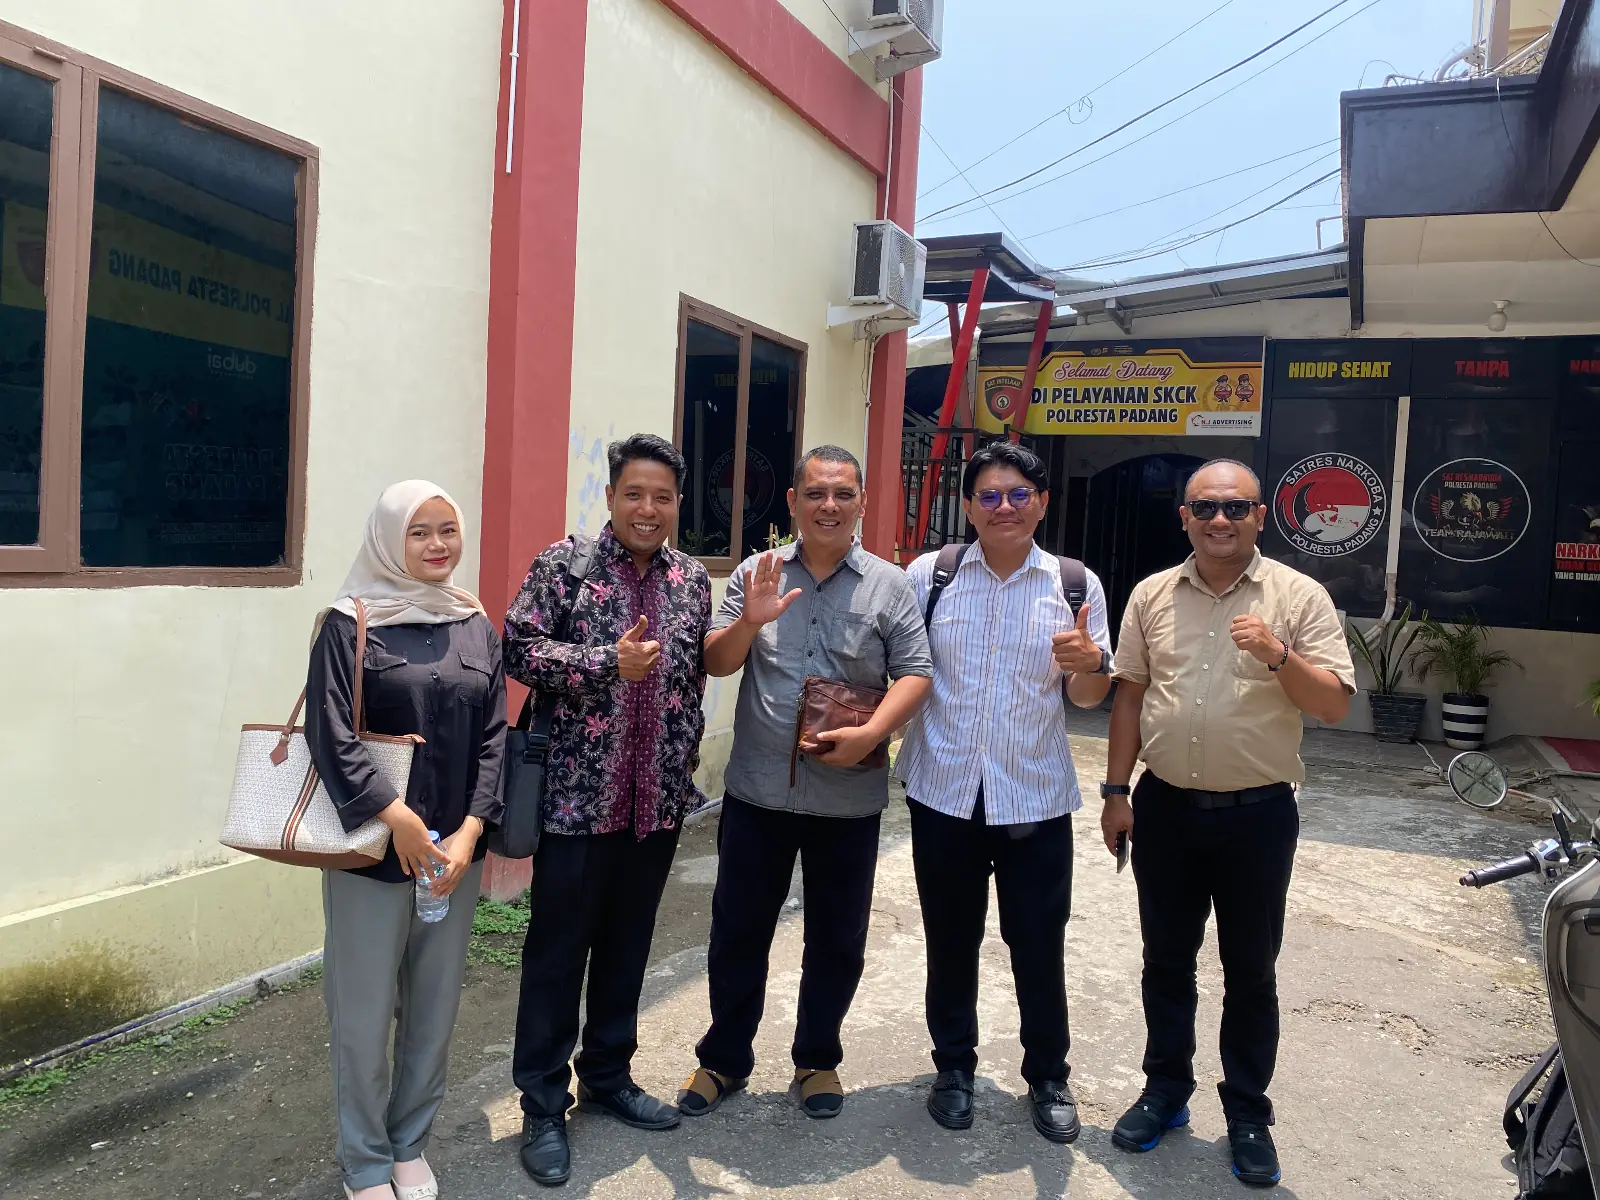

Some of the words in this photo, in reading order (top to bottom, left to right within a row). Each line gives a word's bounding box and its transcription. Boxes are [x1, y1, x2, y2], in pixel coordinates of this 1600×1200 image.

[1054, 361, 1112, 381] Selamat
[1115, 360, 1175, 381] Datang
[1288, 362, 1338, 378] HIDUP
[1341, 361, 1392, 378] SEHAT
[1455, 360, 1510, 378] TANPA
[1031, 387, 1047, 404] DI
[1051, 386, 1151, 404] PELAYANAN
[1154, 386, 1198, 404] SKCK
[1046, 408, 1116, 424] POLRESTA
[1119, 408, 1178, 424] PADANG
[1285, 456, 1334, 485] SATRES
[1336, 456, 1384, 504] NARKOBA
[1291, 533, 1344, 554] POLRESTA
[1344, 516, 1380, 551] PADANG
[1556, 542, 1600, 560] NARK
[1555, 571, 1574, 580] YANG
